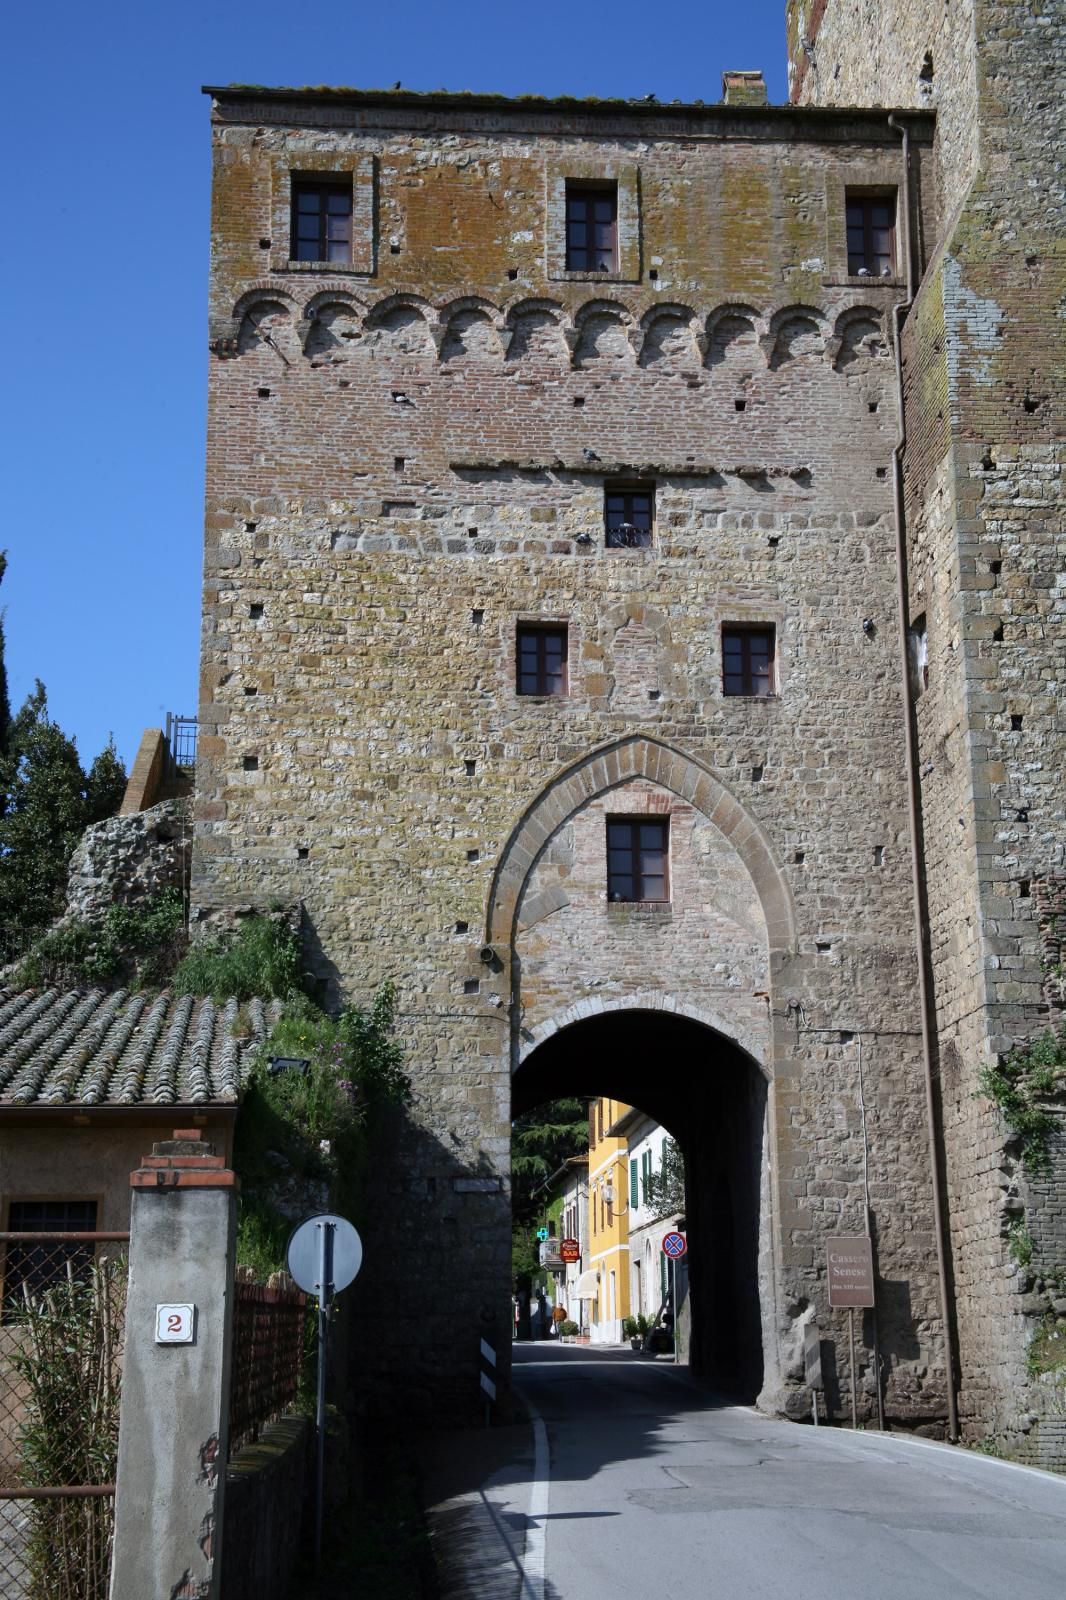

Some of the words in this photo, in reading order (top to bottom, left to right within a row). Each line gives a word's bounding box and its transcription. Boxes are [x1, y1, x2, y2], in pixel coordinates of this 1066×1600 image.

[830, 1253, 869, 1263] Cassero
[833, 1266, 867, 1276] Senese
[167, 1314, 182, 1333] 2
